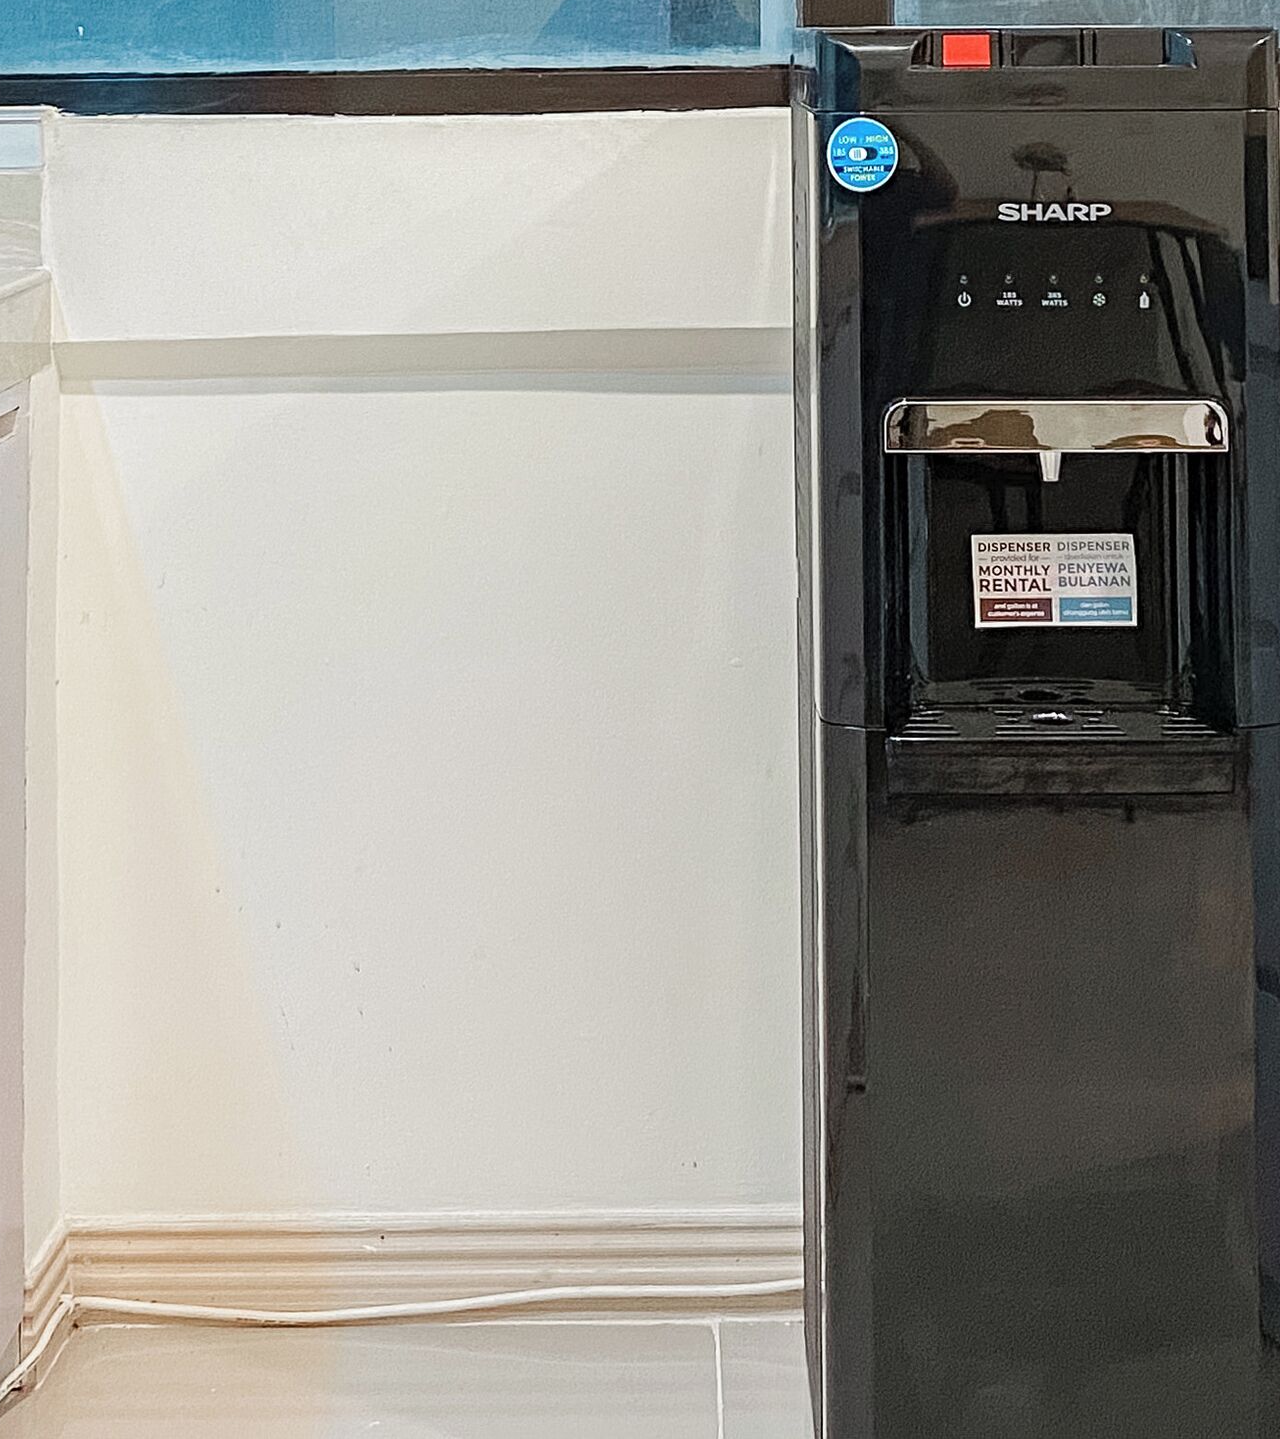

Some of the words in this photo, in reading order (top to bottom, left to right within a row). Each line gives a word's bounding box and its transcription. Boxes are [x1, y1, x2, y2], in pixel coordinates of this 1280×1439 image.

[838, 135, 857, 144] LOW
[997, 203, 1112, 222] SHARP
[1041, 299, 1069, 307] WATTS
[977, 542, 1051, 552] DISPENSER
[1057, 541, 1130, 551] DISPENSER
[991, 554, 1027, 563] provided
[1028, 553, 1040, 561] for
[978, 565, 1051, 576] MONTHLY
[1058, 562, 1128, 574] PENYEWA
[979, 578, 1052, 592] RENTAL
[1058, 575, 1131, 587] BULANAN
